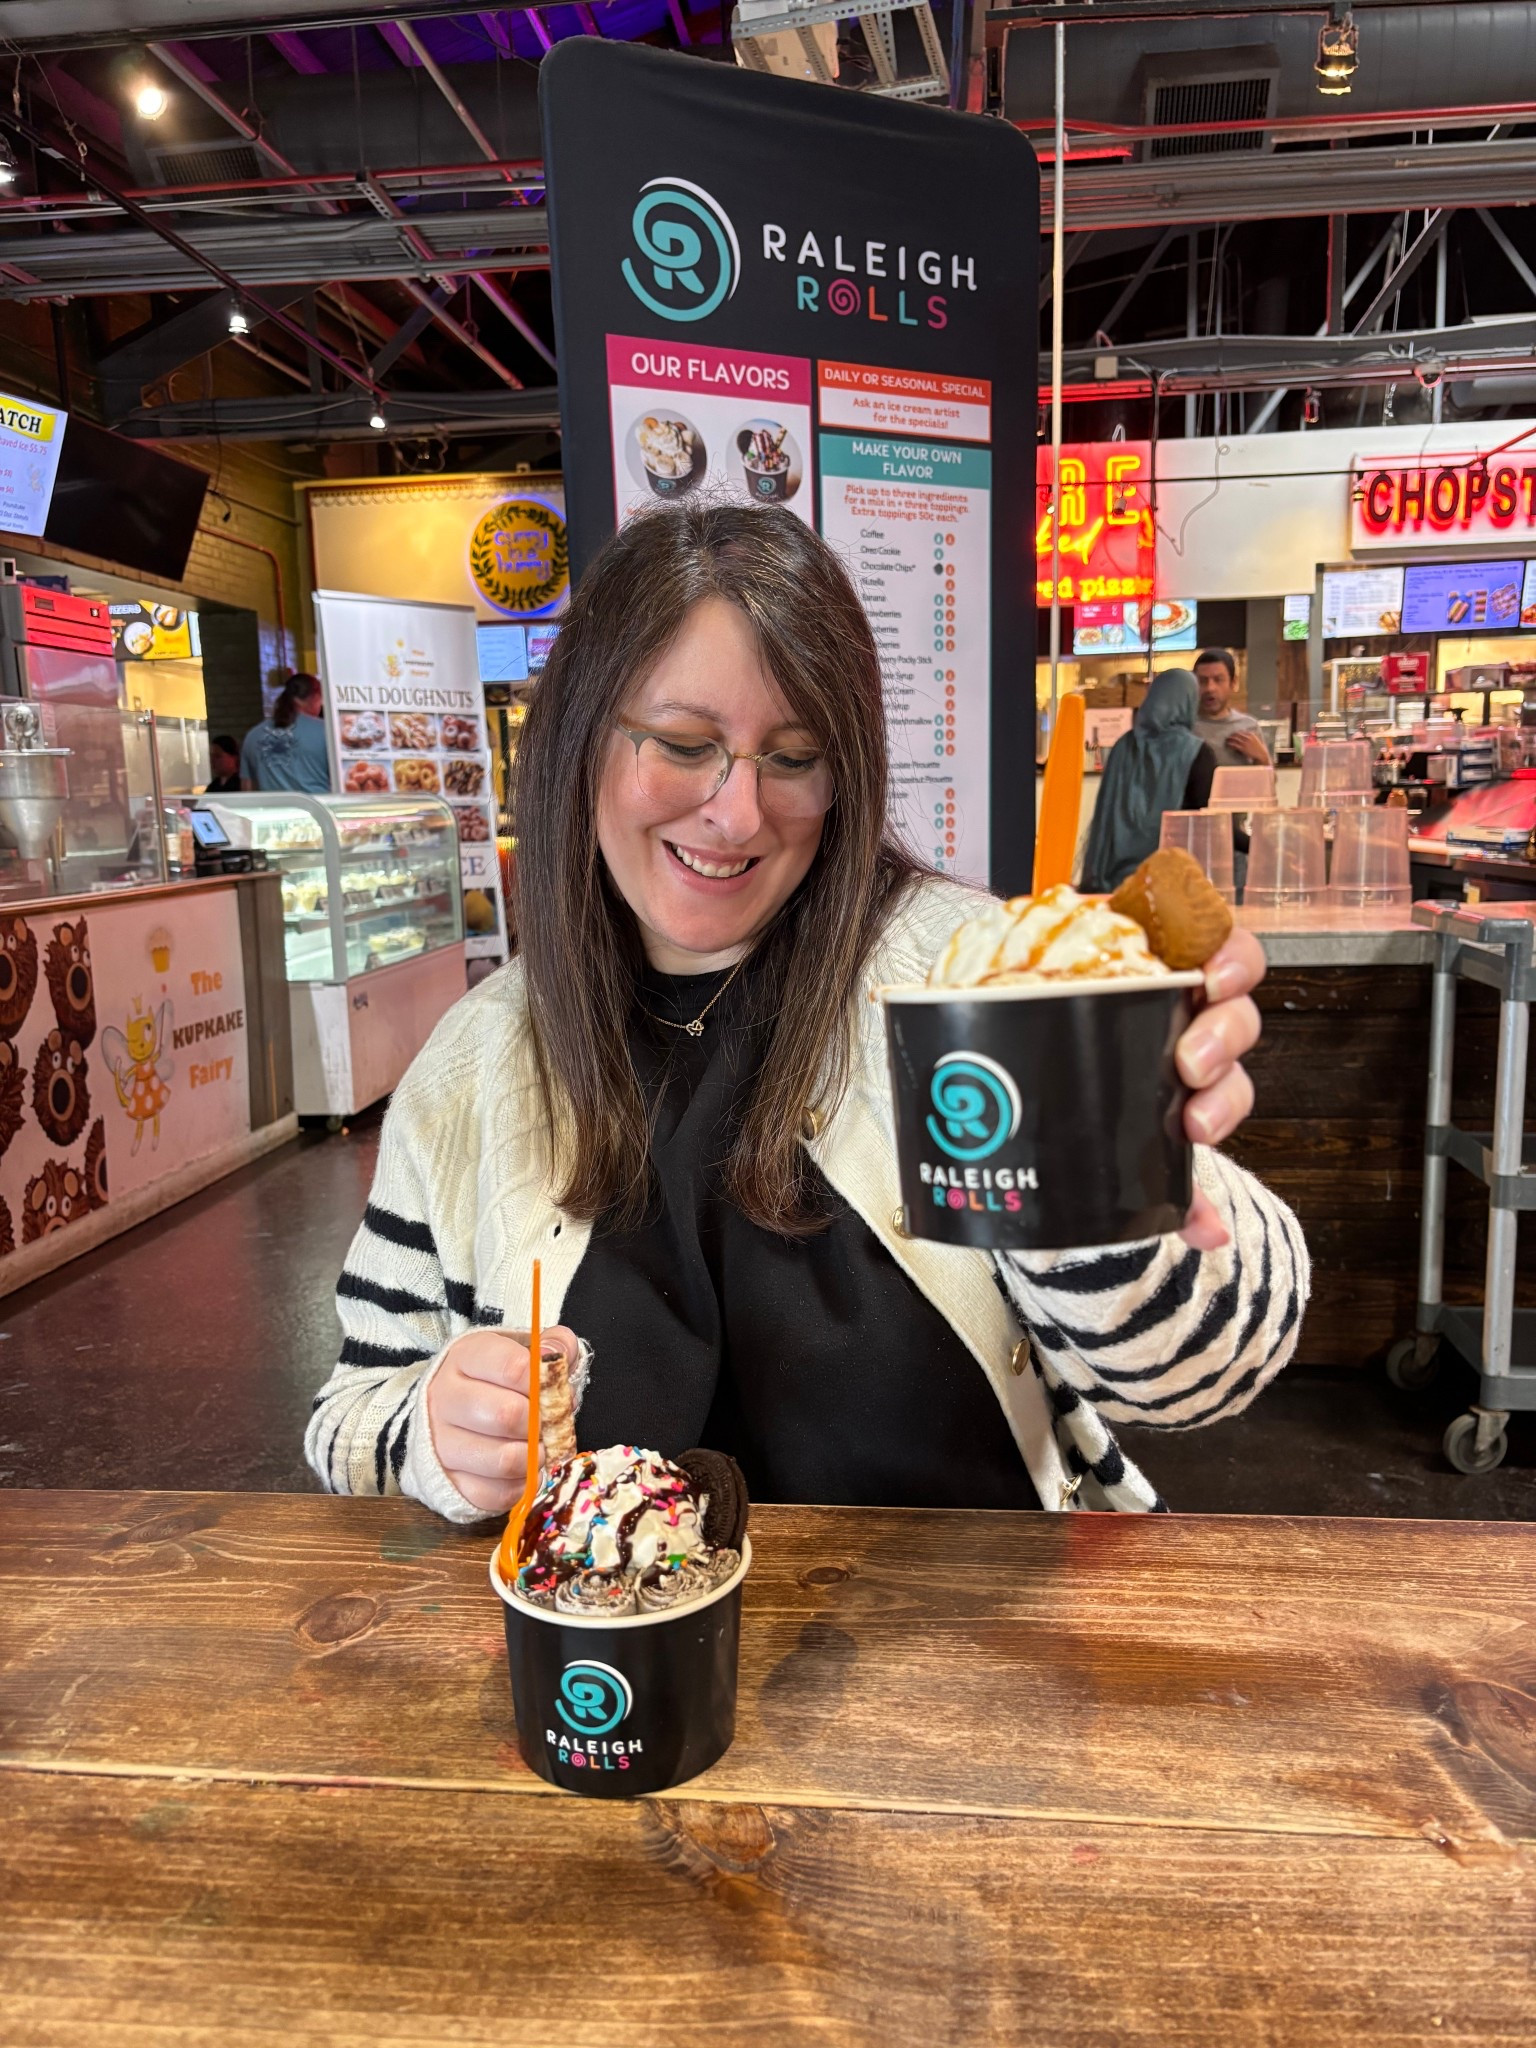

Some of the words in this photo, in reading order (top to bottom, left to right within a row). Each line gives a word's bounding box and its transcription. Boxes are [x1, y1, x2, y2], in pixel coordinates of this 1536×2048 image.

[763, 224, 977, 291] RALEIGH
[797, 275, 948, 329] ROLLS
[631, 353, 681, 378] OUR
[688, 359, 790, 390] FLAVORS
[824, 367, 860, 383] DAILY
[862, 373, 878, 385] OR
[881, 375, 939, 392] SEASONAL
[942, 383, 985, 398] SPECIAL
[853, 398, 870, 408] Ask
[873, 400, 885, 409] an
[887, 400, 900, 411] ice
[903, 404, 931, 415] cream
[934, 405, 960, 418] artist
[873, 413, 888, 423] for
[890, 414, 906, 425] the
[908, 417, 948, 429] specials!
[852, 441, 889, 457] MAKE
[892, 445, 928, 461] YOUR
[931, 449, 961, 464] OWN
[883, 462, 933, 479] FLAVOR
[844, 495, 857, 504] for
[868, 498, 885, 506] mix
[886, 498, 895, 507] in
[904, 500, 928, 510] three
[846, 484, 864, 494] Pick
[867, 487, 878, 496] up
[880, 488, 891, 496] to
[892, 489, 916, 498] three
[919, 490, 968, 503] ingredients
[851, 506, 875, 516] Extra
[878, 509, 917, 521] toppings
[860, 529, 884, 539] Coffee
[879, 547, 901, 555] Cookie
[861, 561, 893, 571] Chocolate
[866, 610, 902, 618] rawberries
[335, 685, 373, 704] MINI
[378, 686, 474, 709] DOUGHNUTS
[191, 970, 222, 995] The
[172, 1009, 244, 1050] KUPKAKE
[189, 1056, 233, 1089] Fairy
[920, 1162, 1039, 1190] RALEIGH
[933, 1186, 1023, 1212] ROLLS
[546, 1729, 643, 1755] RALEIGH
[558, 1748, 630, 1770] ROLLS
